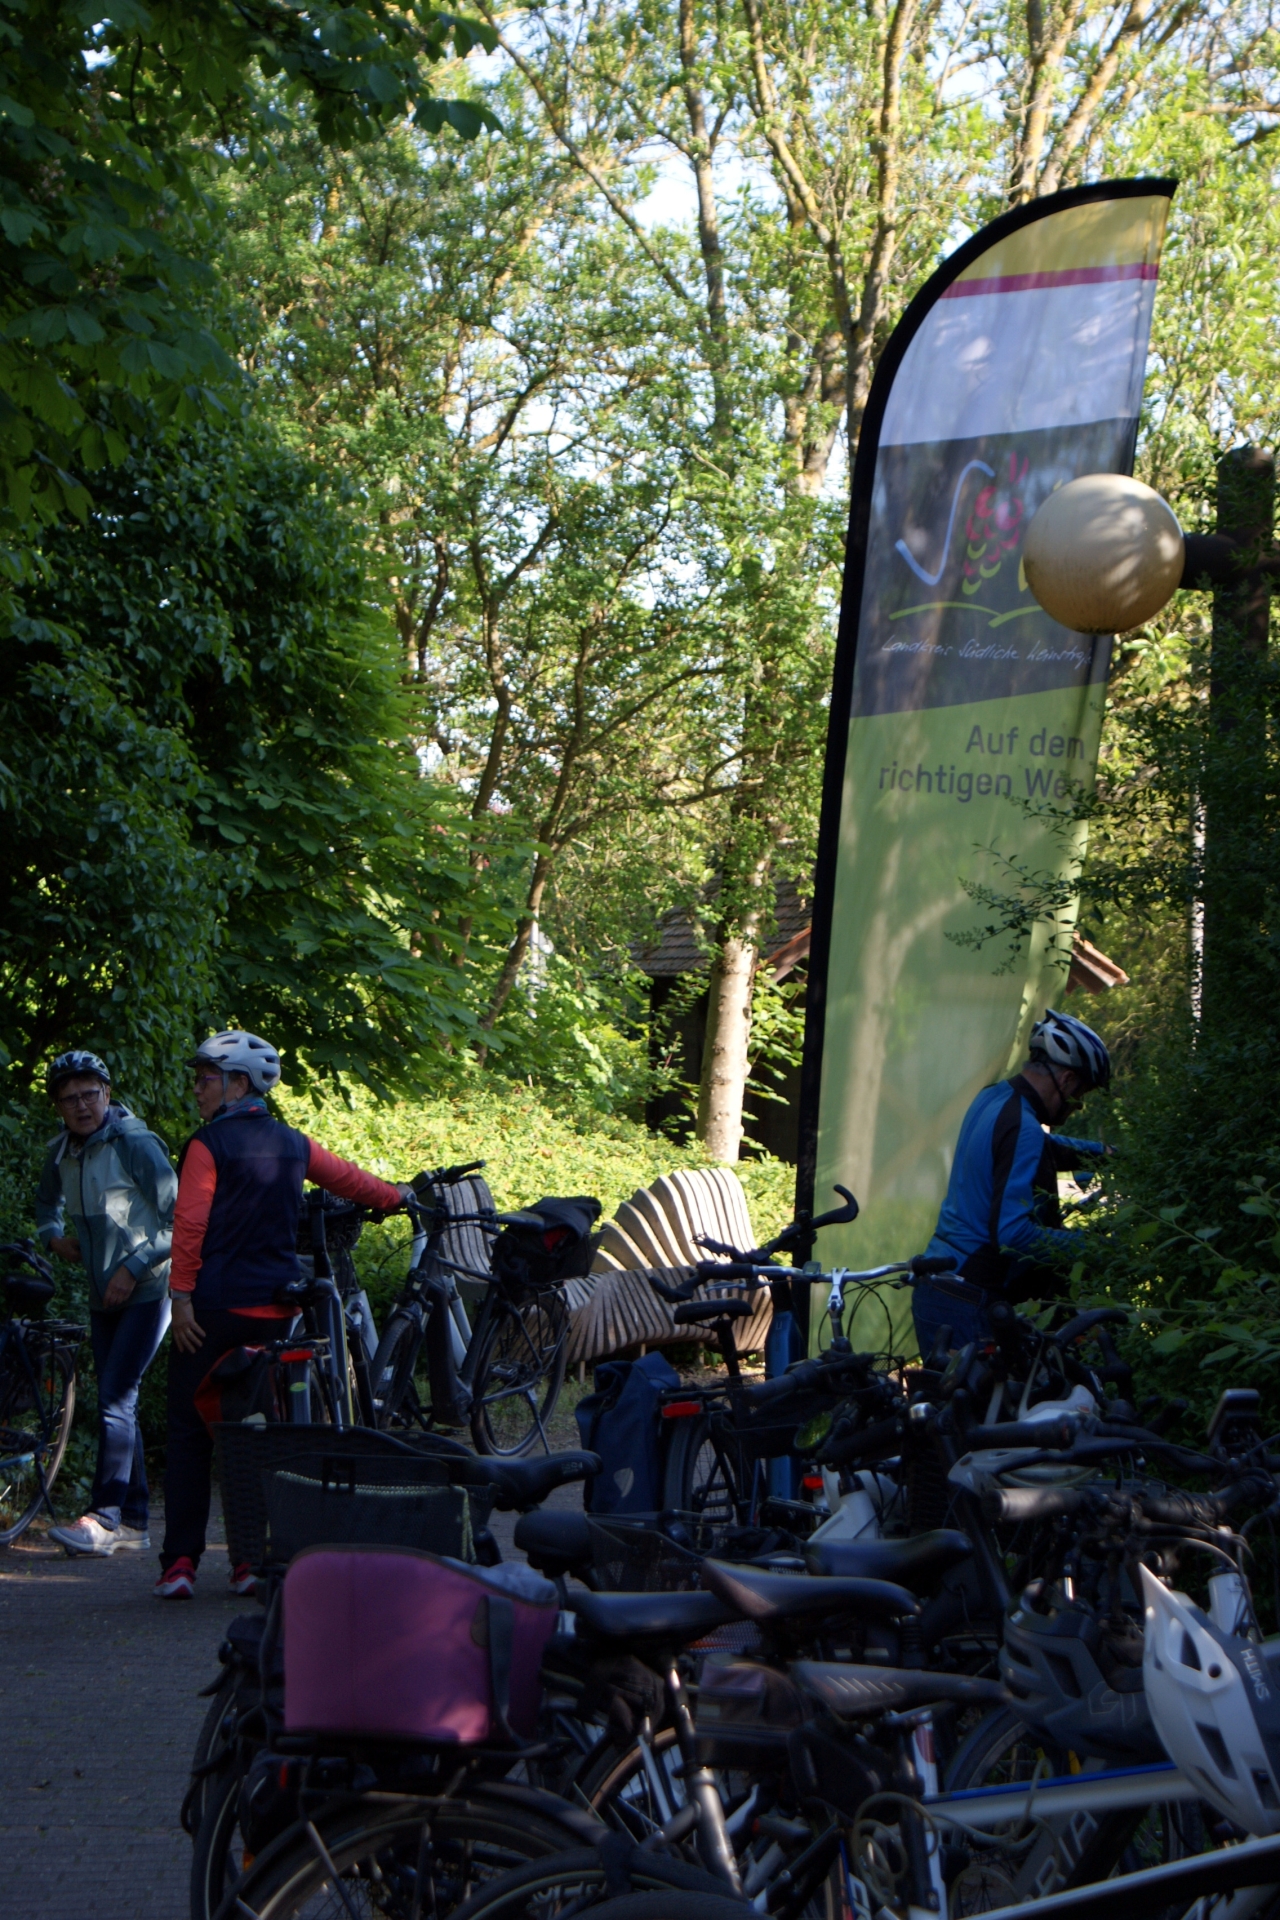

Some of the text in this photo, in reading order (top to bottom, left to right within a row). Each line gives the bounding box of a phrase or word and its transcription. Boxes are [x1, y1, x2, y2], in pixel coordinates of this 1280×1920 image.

[882, 636, 953, 656] Landkreis
[959, 638, 1020, 660] Südliche
[965, 725, 1084, 759] Auf dem
[879, 761, 1012, 803] richtigen
[1240, 1647, 1271, 1701] SMITH
